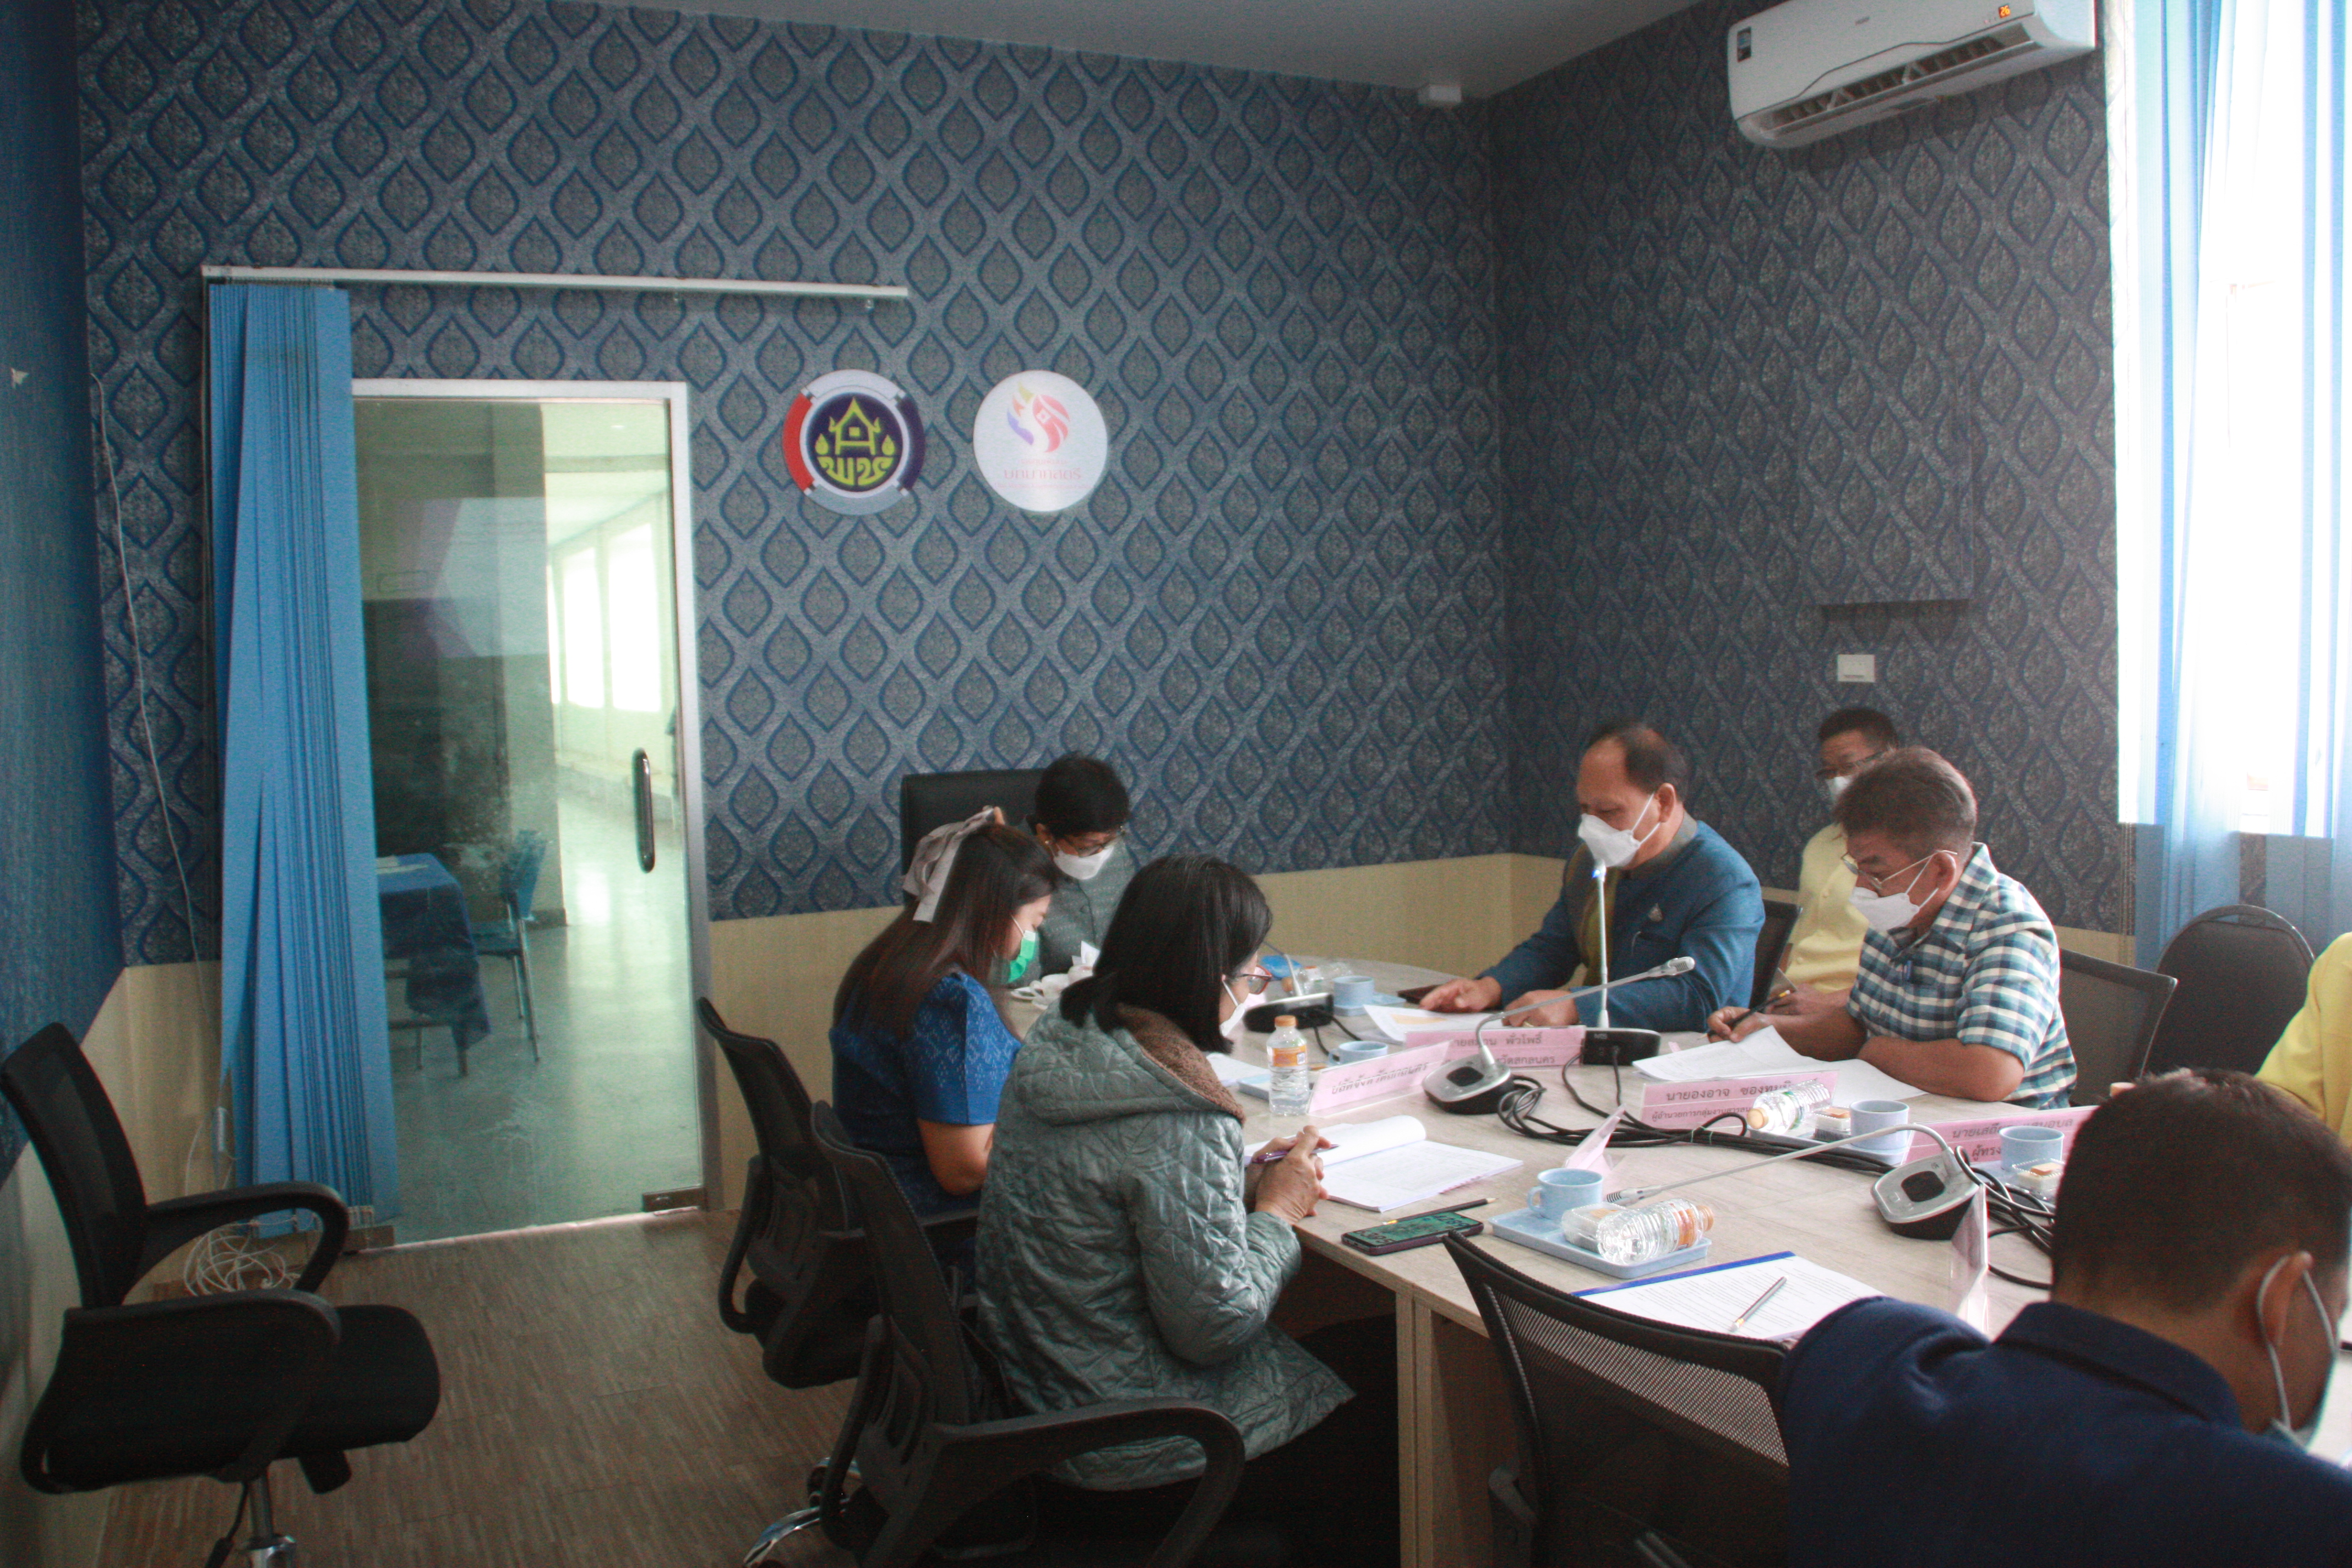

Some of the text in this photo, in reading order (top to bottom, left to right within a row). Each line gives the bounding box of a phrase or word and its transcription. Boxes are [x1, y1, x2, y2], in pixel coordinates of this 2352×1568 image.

[2000, 4, 2011, 17] 26
[1666, 1087, 1730, 1101] นายองอาจ
